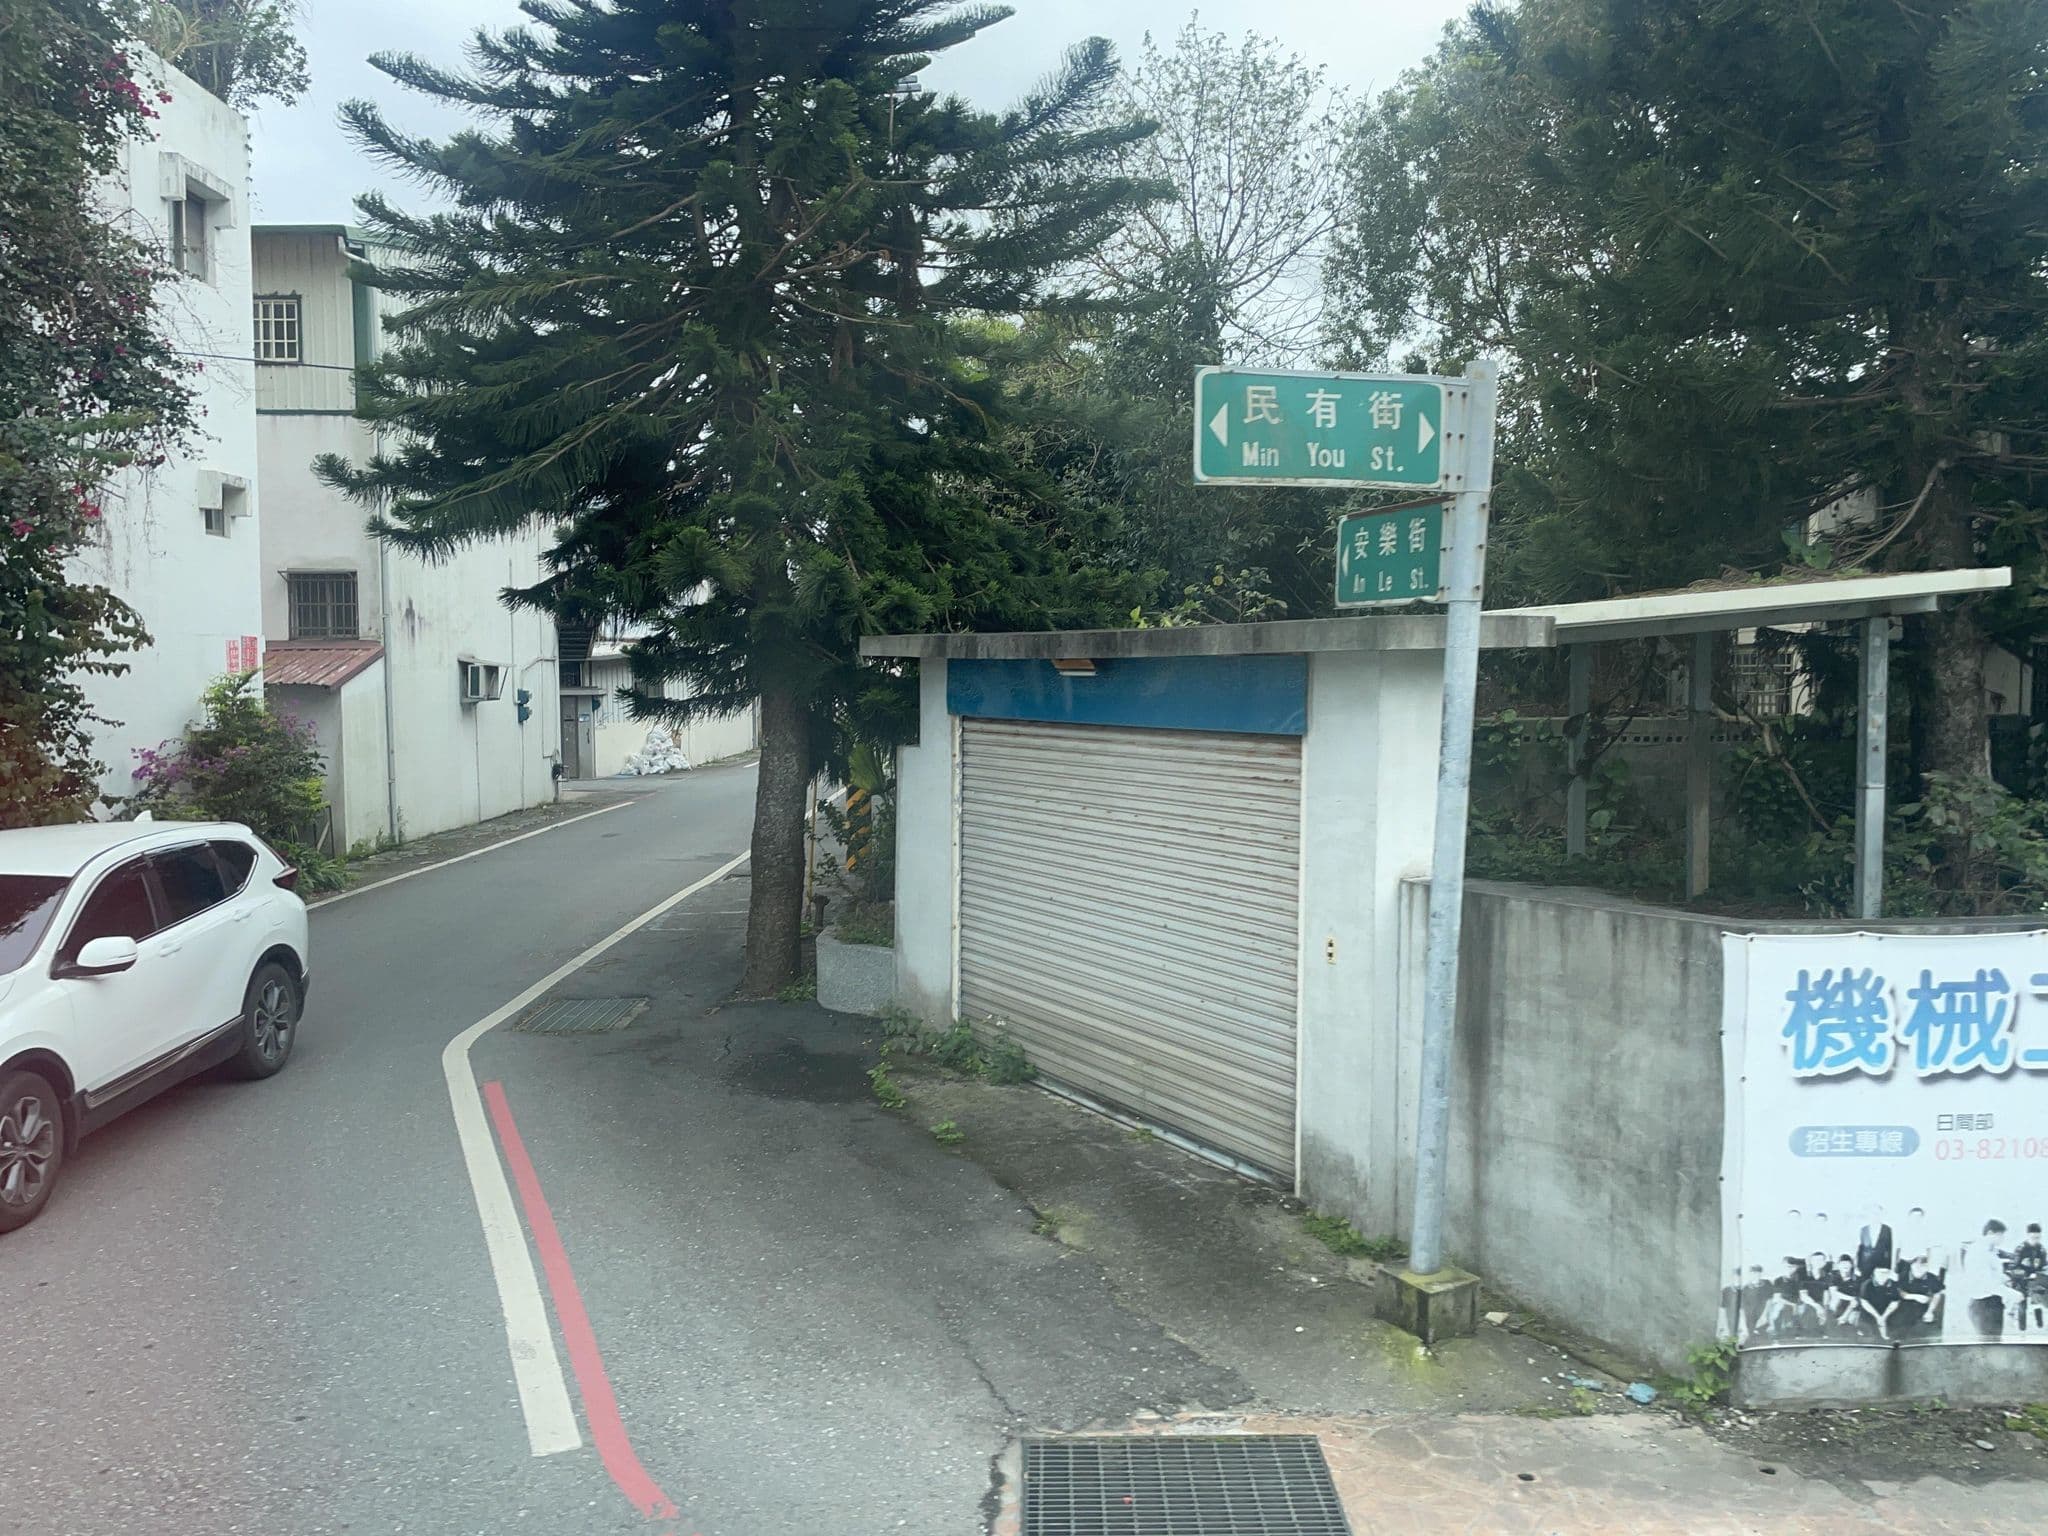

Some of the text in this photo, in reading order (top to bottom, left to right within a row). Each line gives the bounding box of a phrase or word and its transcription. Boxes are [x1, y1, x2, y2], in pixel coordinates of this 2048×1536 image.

[1243, 385, 1404, 430] 民有街
[1242, 441, 1404, 472] Min You St.
[1354, 518, 1426, 560] 安樂街
[1409, 567, 1430, 590] St.
[1783, 967, 2048, 1070] 機械
[1937, 1113, 1994, 1131] 日間部
[1805, 1130, 1904, 1153] 招生專線
